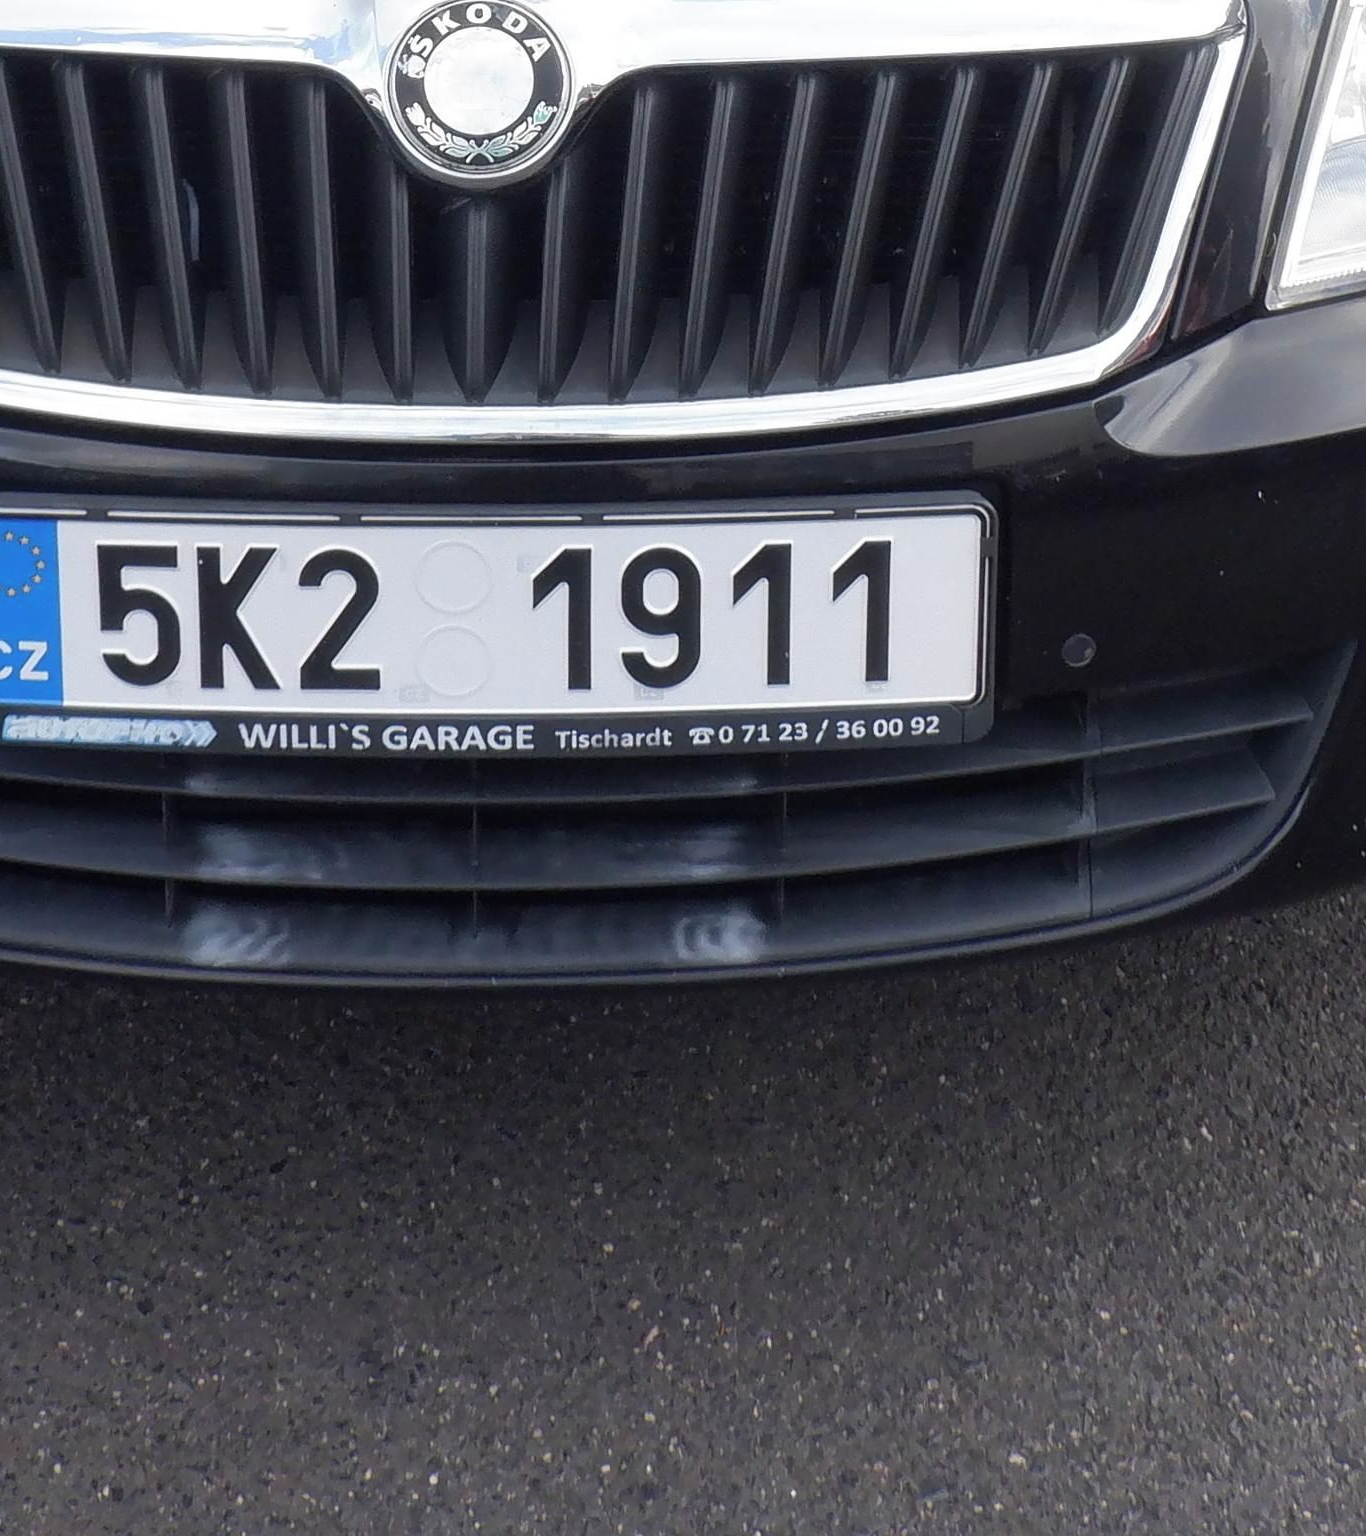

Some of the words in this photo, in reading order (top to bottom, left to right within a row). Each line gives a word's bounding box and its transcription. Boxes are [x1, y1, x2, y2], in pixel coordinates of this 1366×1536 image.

[96, 543, 382, 691] 5K2
[531, 539, 892, 691] 1911
[381, 723, 535, 751] GARAGE
[555, 728, 673, 750] Tischardt
